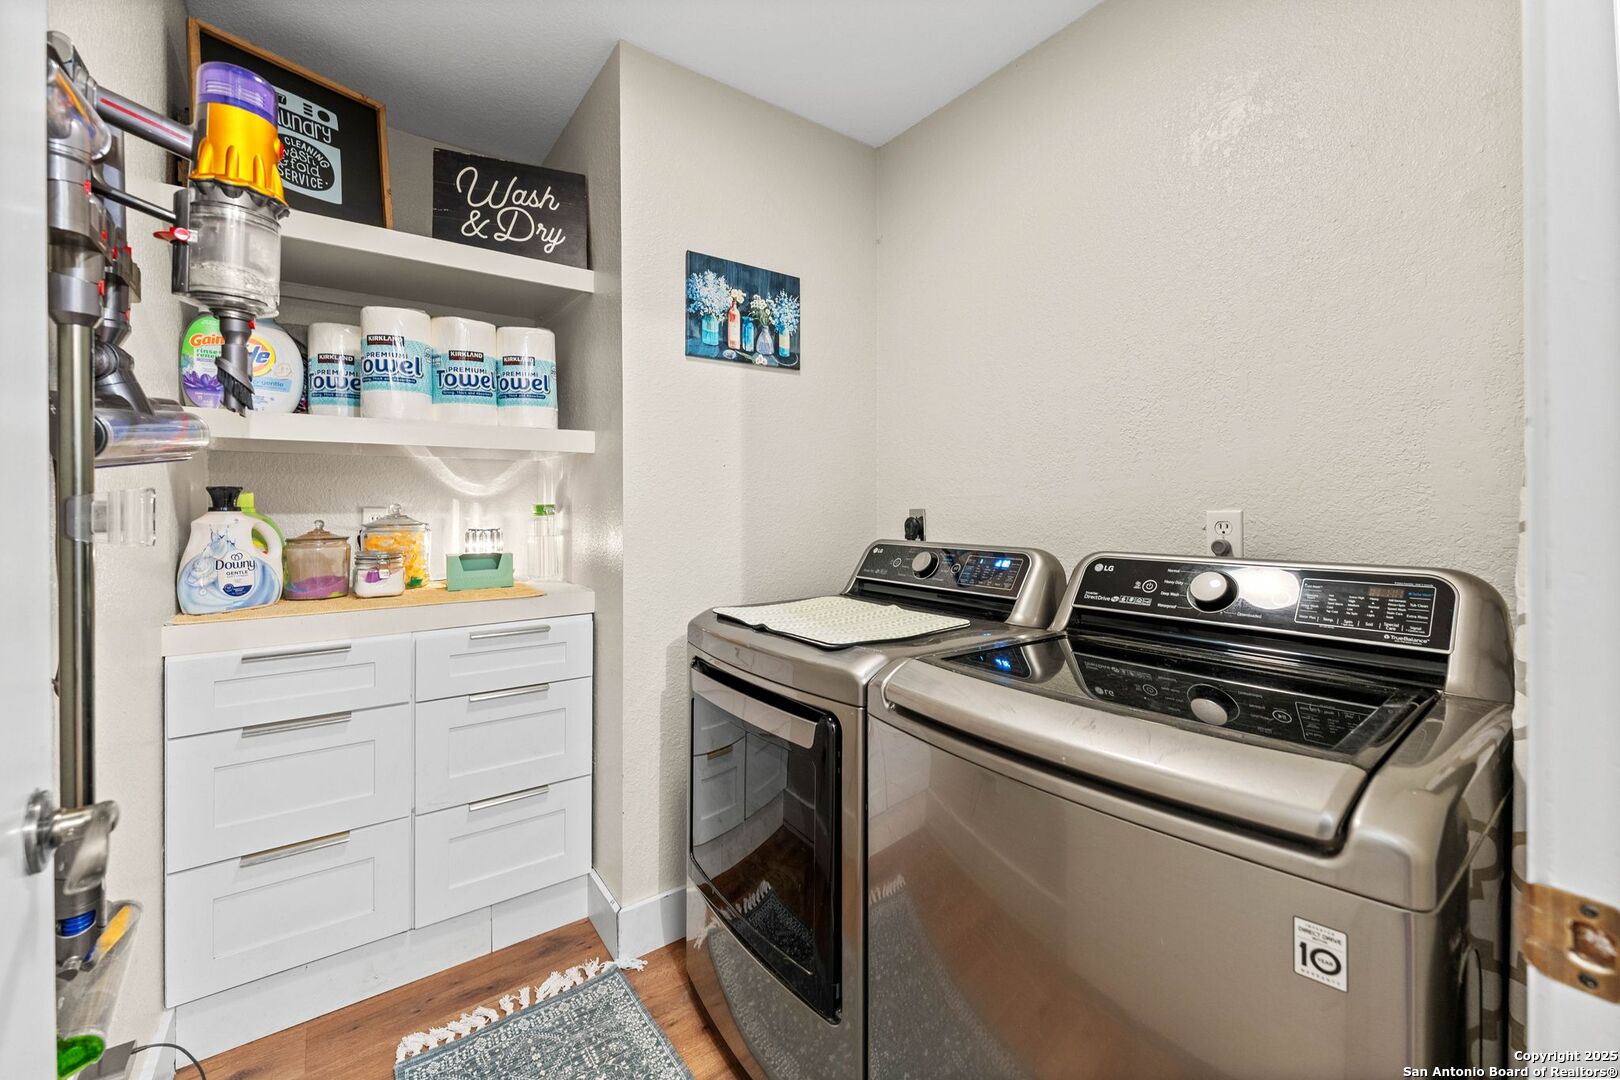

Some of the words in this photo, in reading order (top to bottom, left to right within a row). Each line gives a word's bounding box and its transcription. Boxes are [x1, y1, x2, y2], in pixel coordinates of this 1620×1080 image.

[278, 110, 332, 143] undry
[284, 137, 330, 168] CLEANING
[278, 164, 323, 189] SERVICE
[290, 158, 320, 178] fold
[456, 167, 560, 210] Wash
[461, 210, 490, 239] &
[494, 207, 566, 253] Dry
[190, 334, 225, 347] Gain
[450, 350, 483, 359] KIRKLAND
[362, 356, 422, 376] owel
[308, 372, 361, 389] Towe
[437, 370, 496, 390] Towel
[215, 560, 256, 571] Downy
[1299, 941, 1342, 976] 10
